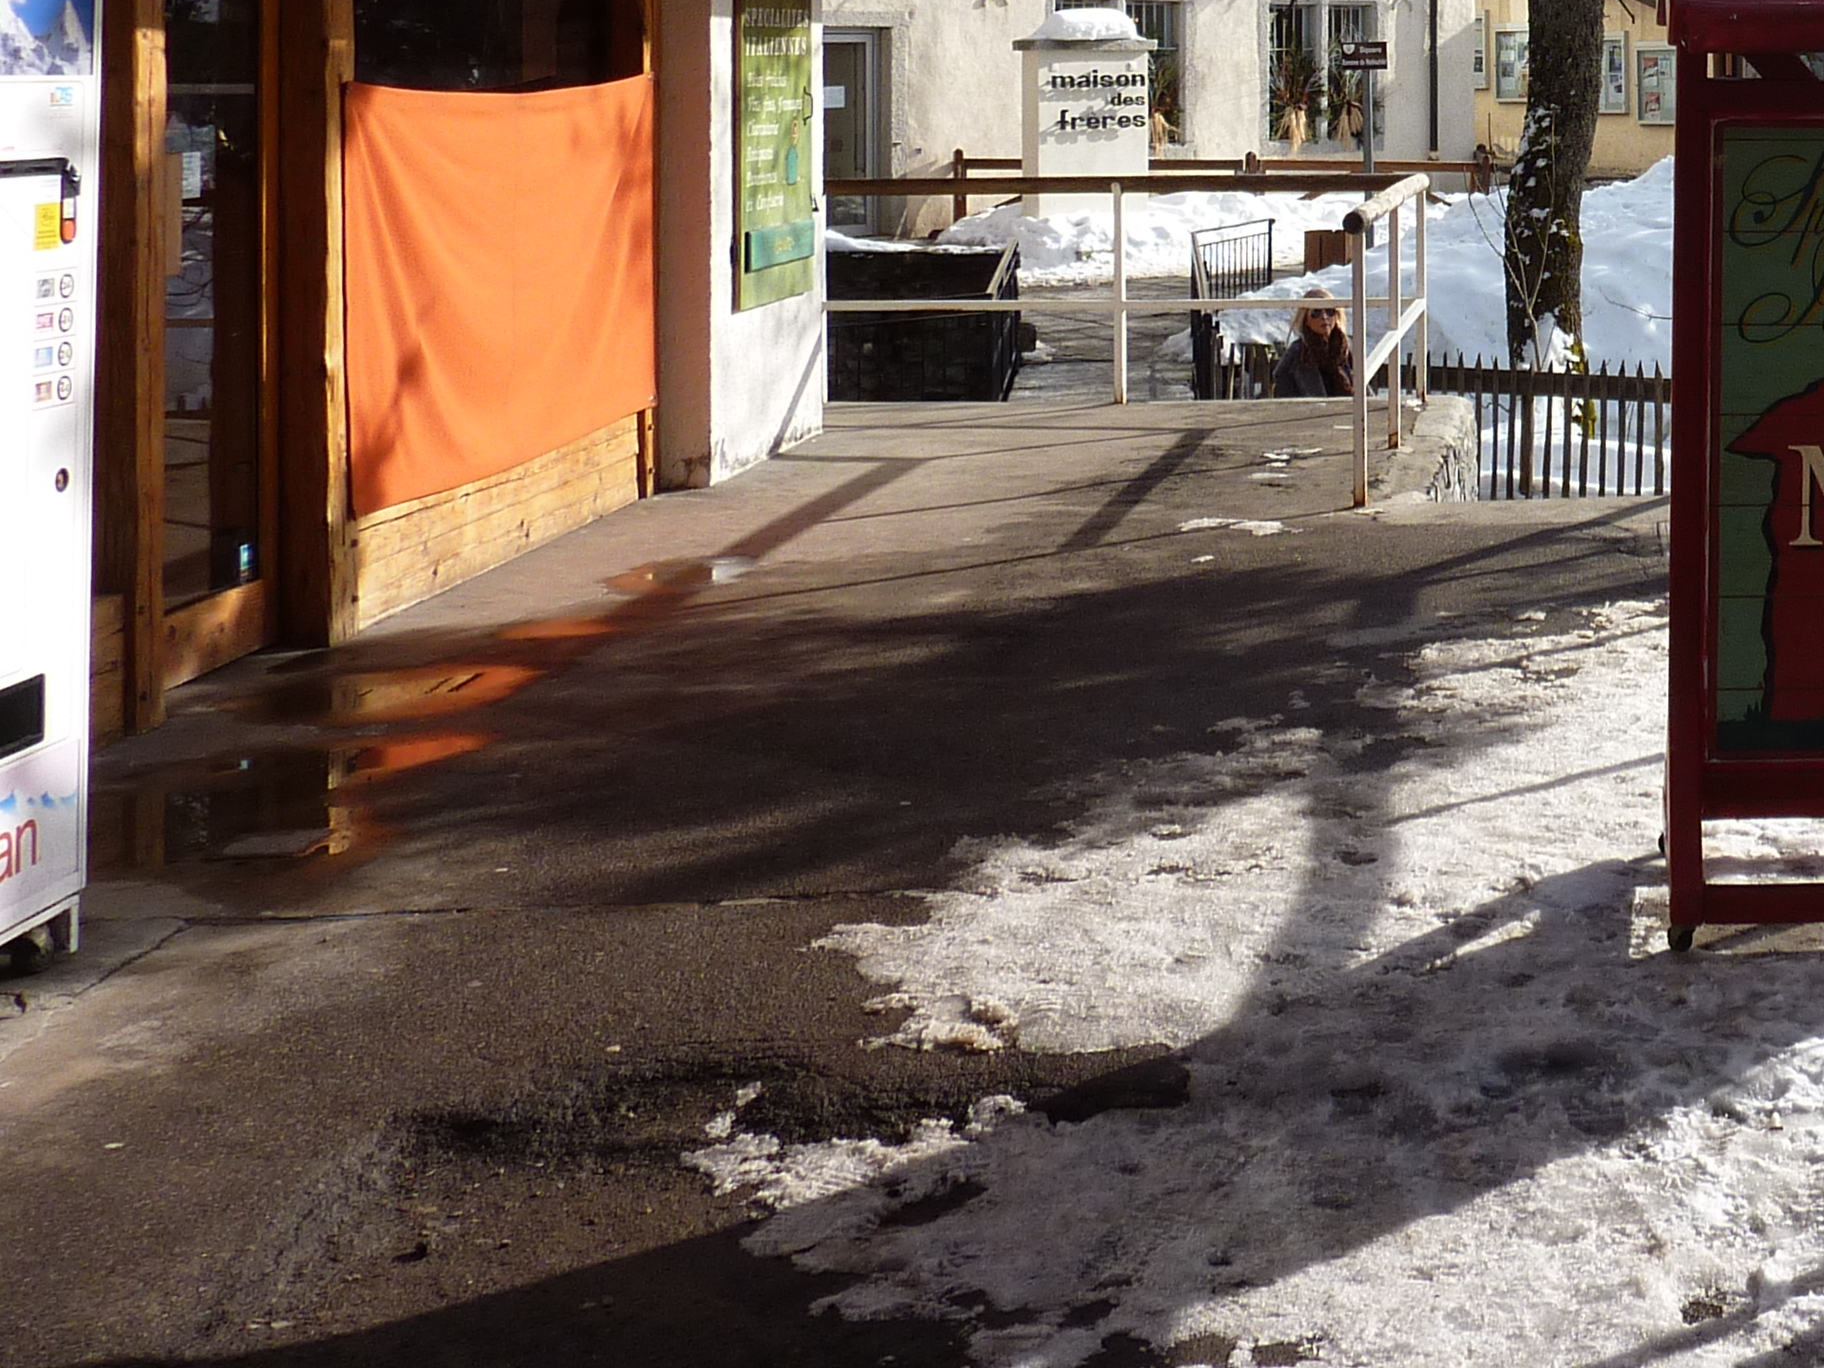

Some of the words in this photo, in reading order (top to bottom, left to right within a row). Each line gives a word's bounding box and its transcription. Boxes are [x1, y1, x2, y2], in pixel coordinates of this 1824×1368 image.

[745, 37, 807, 57] ITALIENNES
[1051, 69, 1146, 89] maison
[1110, 92, 1146, 107] des
[1056, 109, 1147, 131] frères
